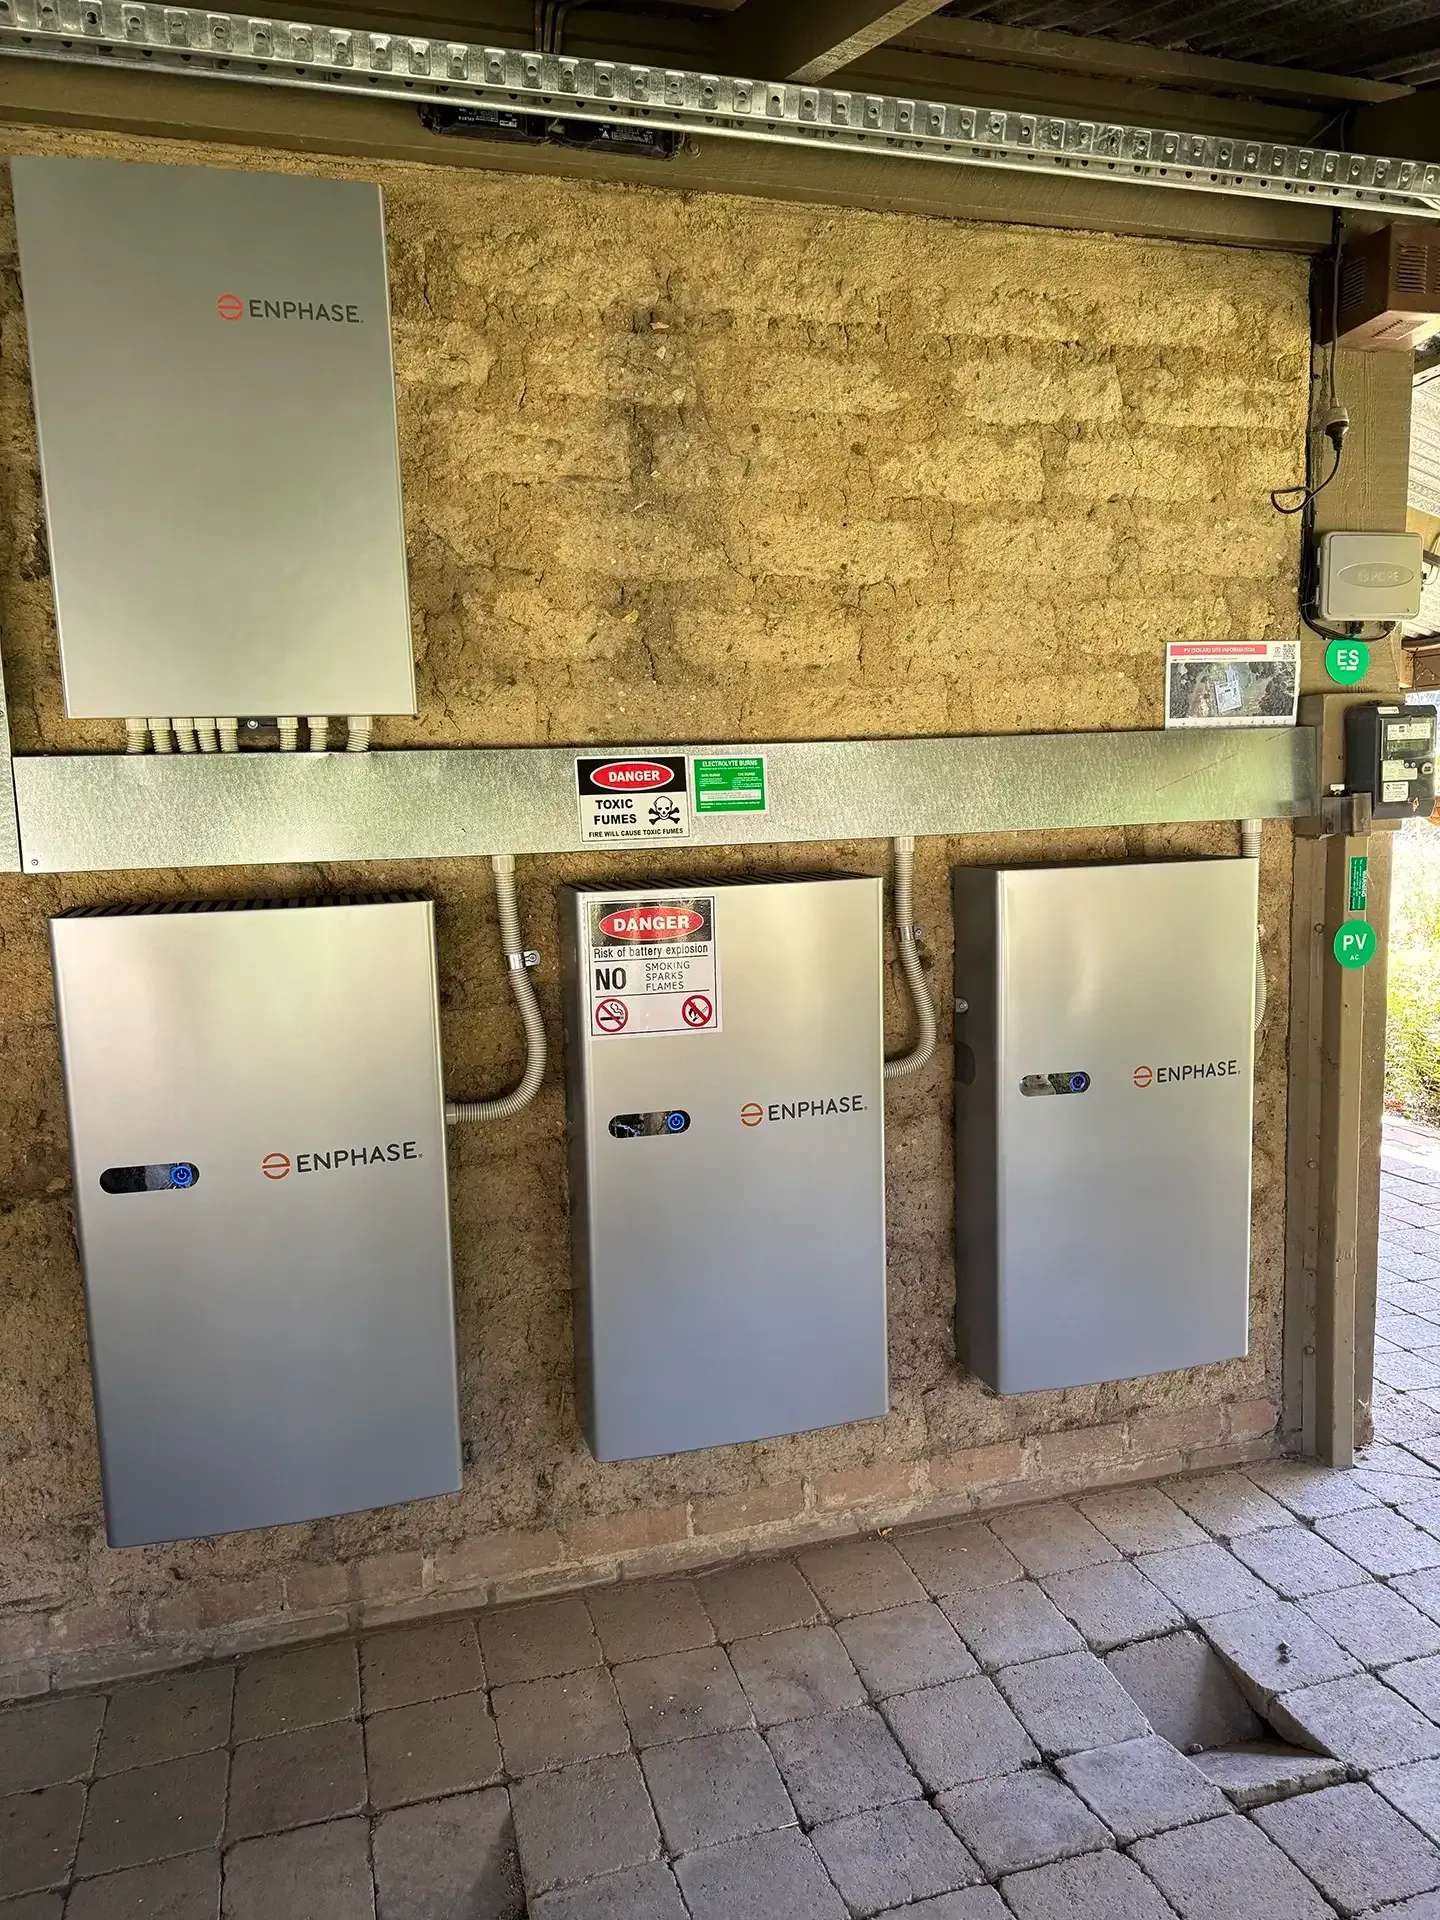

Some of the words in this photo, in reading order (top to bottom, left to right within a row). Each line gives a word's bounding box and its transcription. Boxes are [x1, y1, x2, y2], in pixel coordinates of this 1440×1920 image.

[249, 299, 360, 323] ENPHASE
[1336, 649, 1359, 666] ES
[608, 769, 661, 783] DANGER
[595, 798, 634, 810] TOXIC
[593, 813, 637, 826] FUMES
[588, 830, 602, 838] FIRE
[620, 829, 641, 837] CAUSE
[642, 828, 661, 836] TOXIC
[662, 827, 684, 835] FUMES
[613, 915, 690, 932] DANGER
[1342, 933, 1367, 951] PV
[593, 948, 613, 959] Risk
[617, 946, 626, 957] of
[629, 945, 662, 958] battery
[666, 944, 708, 956] explosion
[645, 960, 690, 972] SMOKING
[595, 967, 627, 991] NO
[645, 971, 684, 981] SPARKS
[645, 981, 684, 991] FLAMES
[1157, 1060, 1237, 1083] ENPHASE
[768, 1095, 864, 1122] ENPHASE
[296, 1141, 418, 1173] ENPHASE
